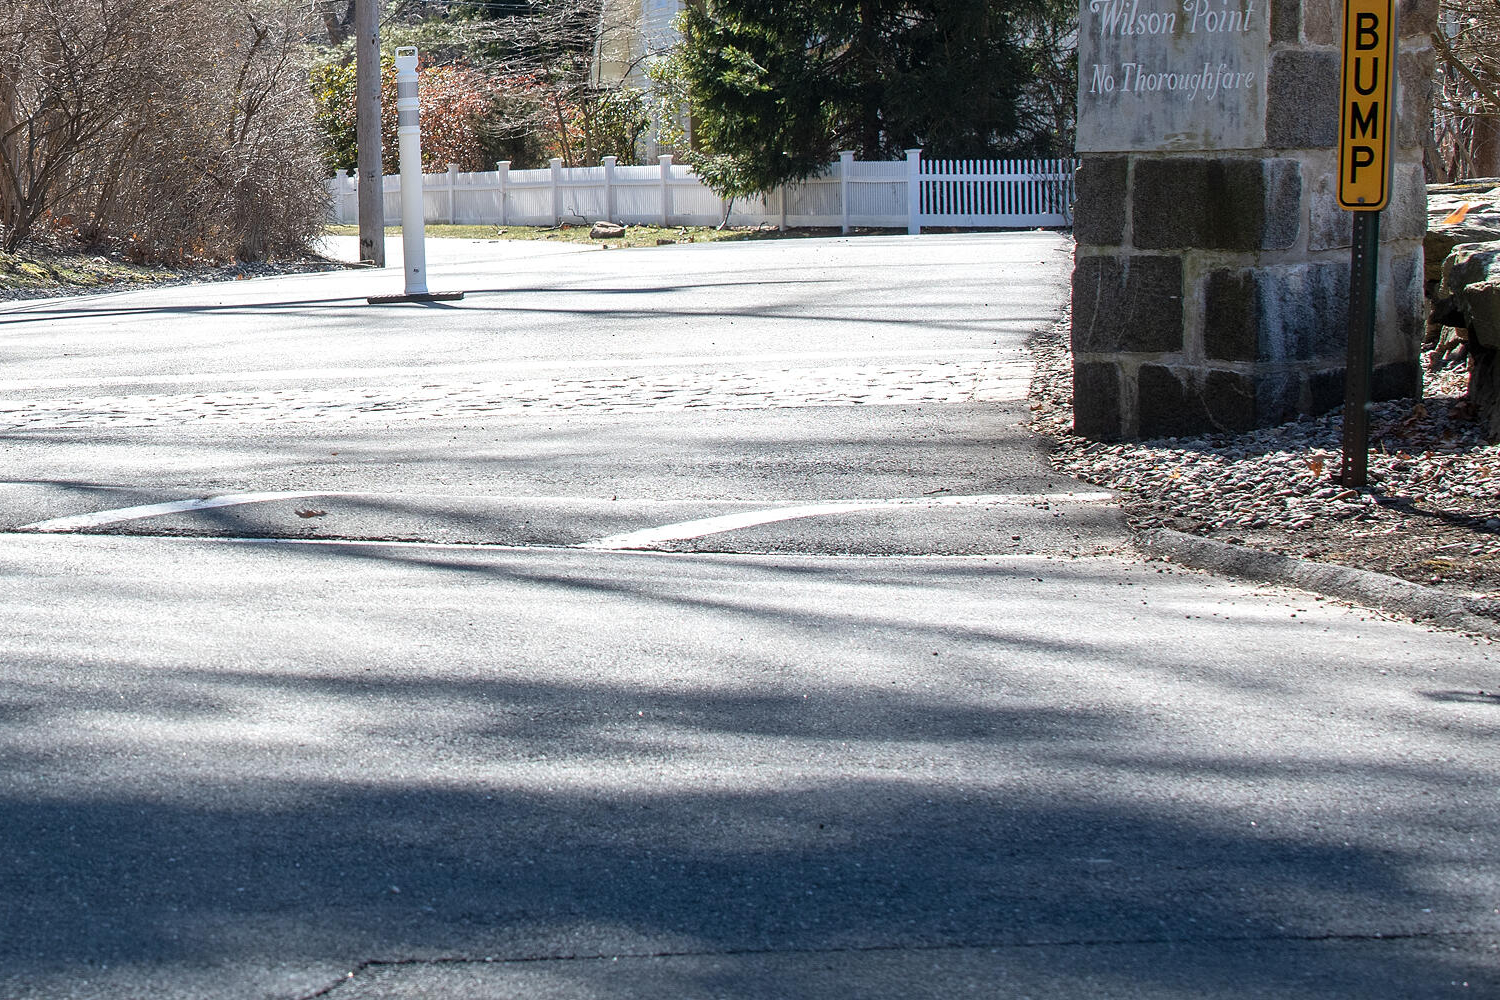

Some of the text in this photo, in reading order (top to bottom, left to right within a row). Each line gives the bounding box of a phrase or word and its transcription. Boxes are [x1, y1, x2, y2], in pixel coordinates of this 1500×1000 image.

[1089, 61, 1255, 101] No Thoroughfare
[1349, 11, 1380, 185] BUMP
